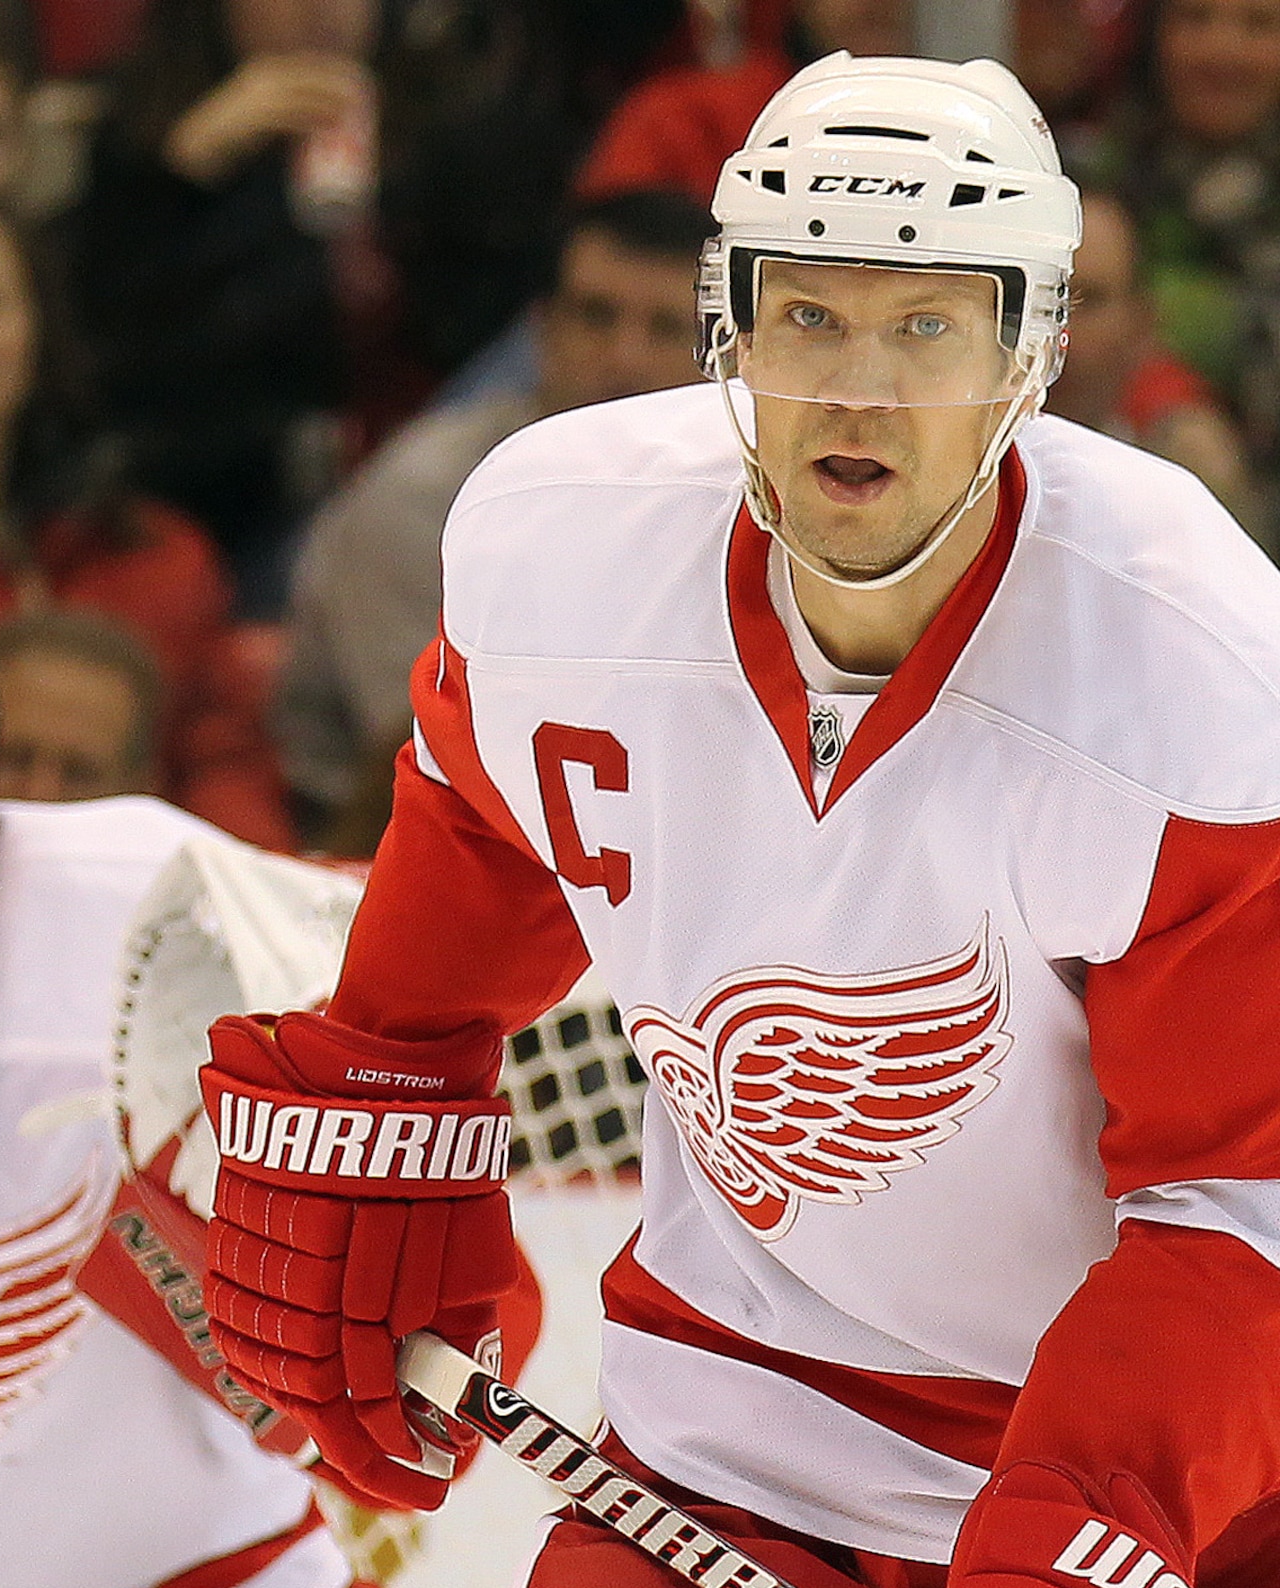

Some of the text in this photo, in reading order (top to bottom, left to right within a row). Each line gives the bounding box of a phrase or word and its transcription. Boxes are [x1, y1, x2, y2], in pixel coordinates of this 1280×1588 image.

[809, 174, 926, 199] CCM
[532, 721, 631, 907] C
[345, 1066, 446, 1090] LIDSTROM
[218, 1090, 512, 1181] WARRIOR
